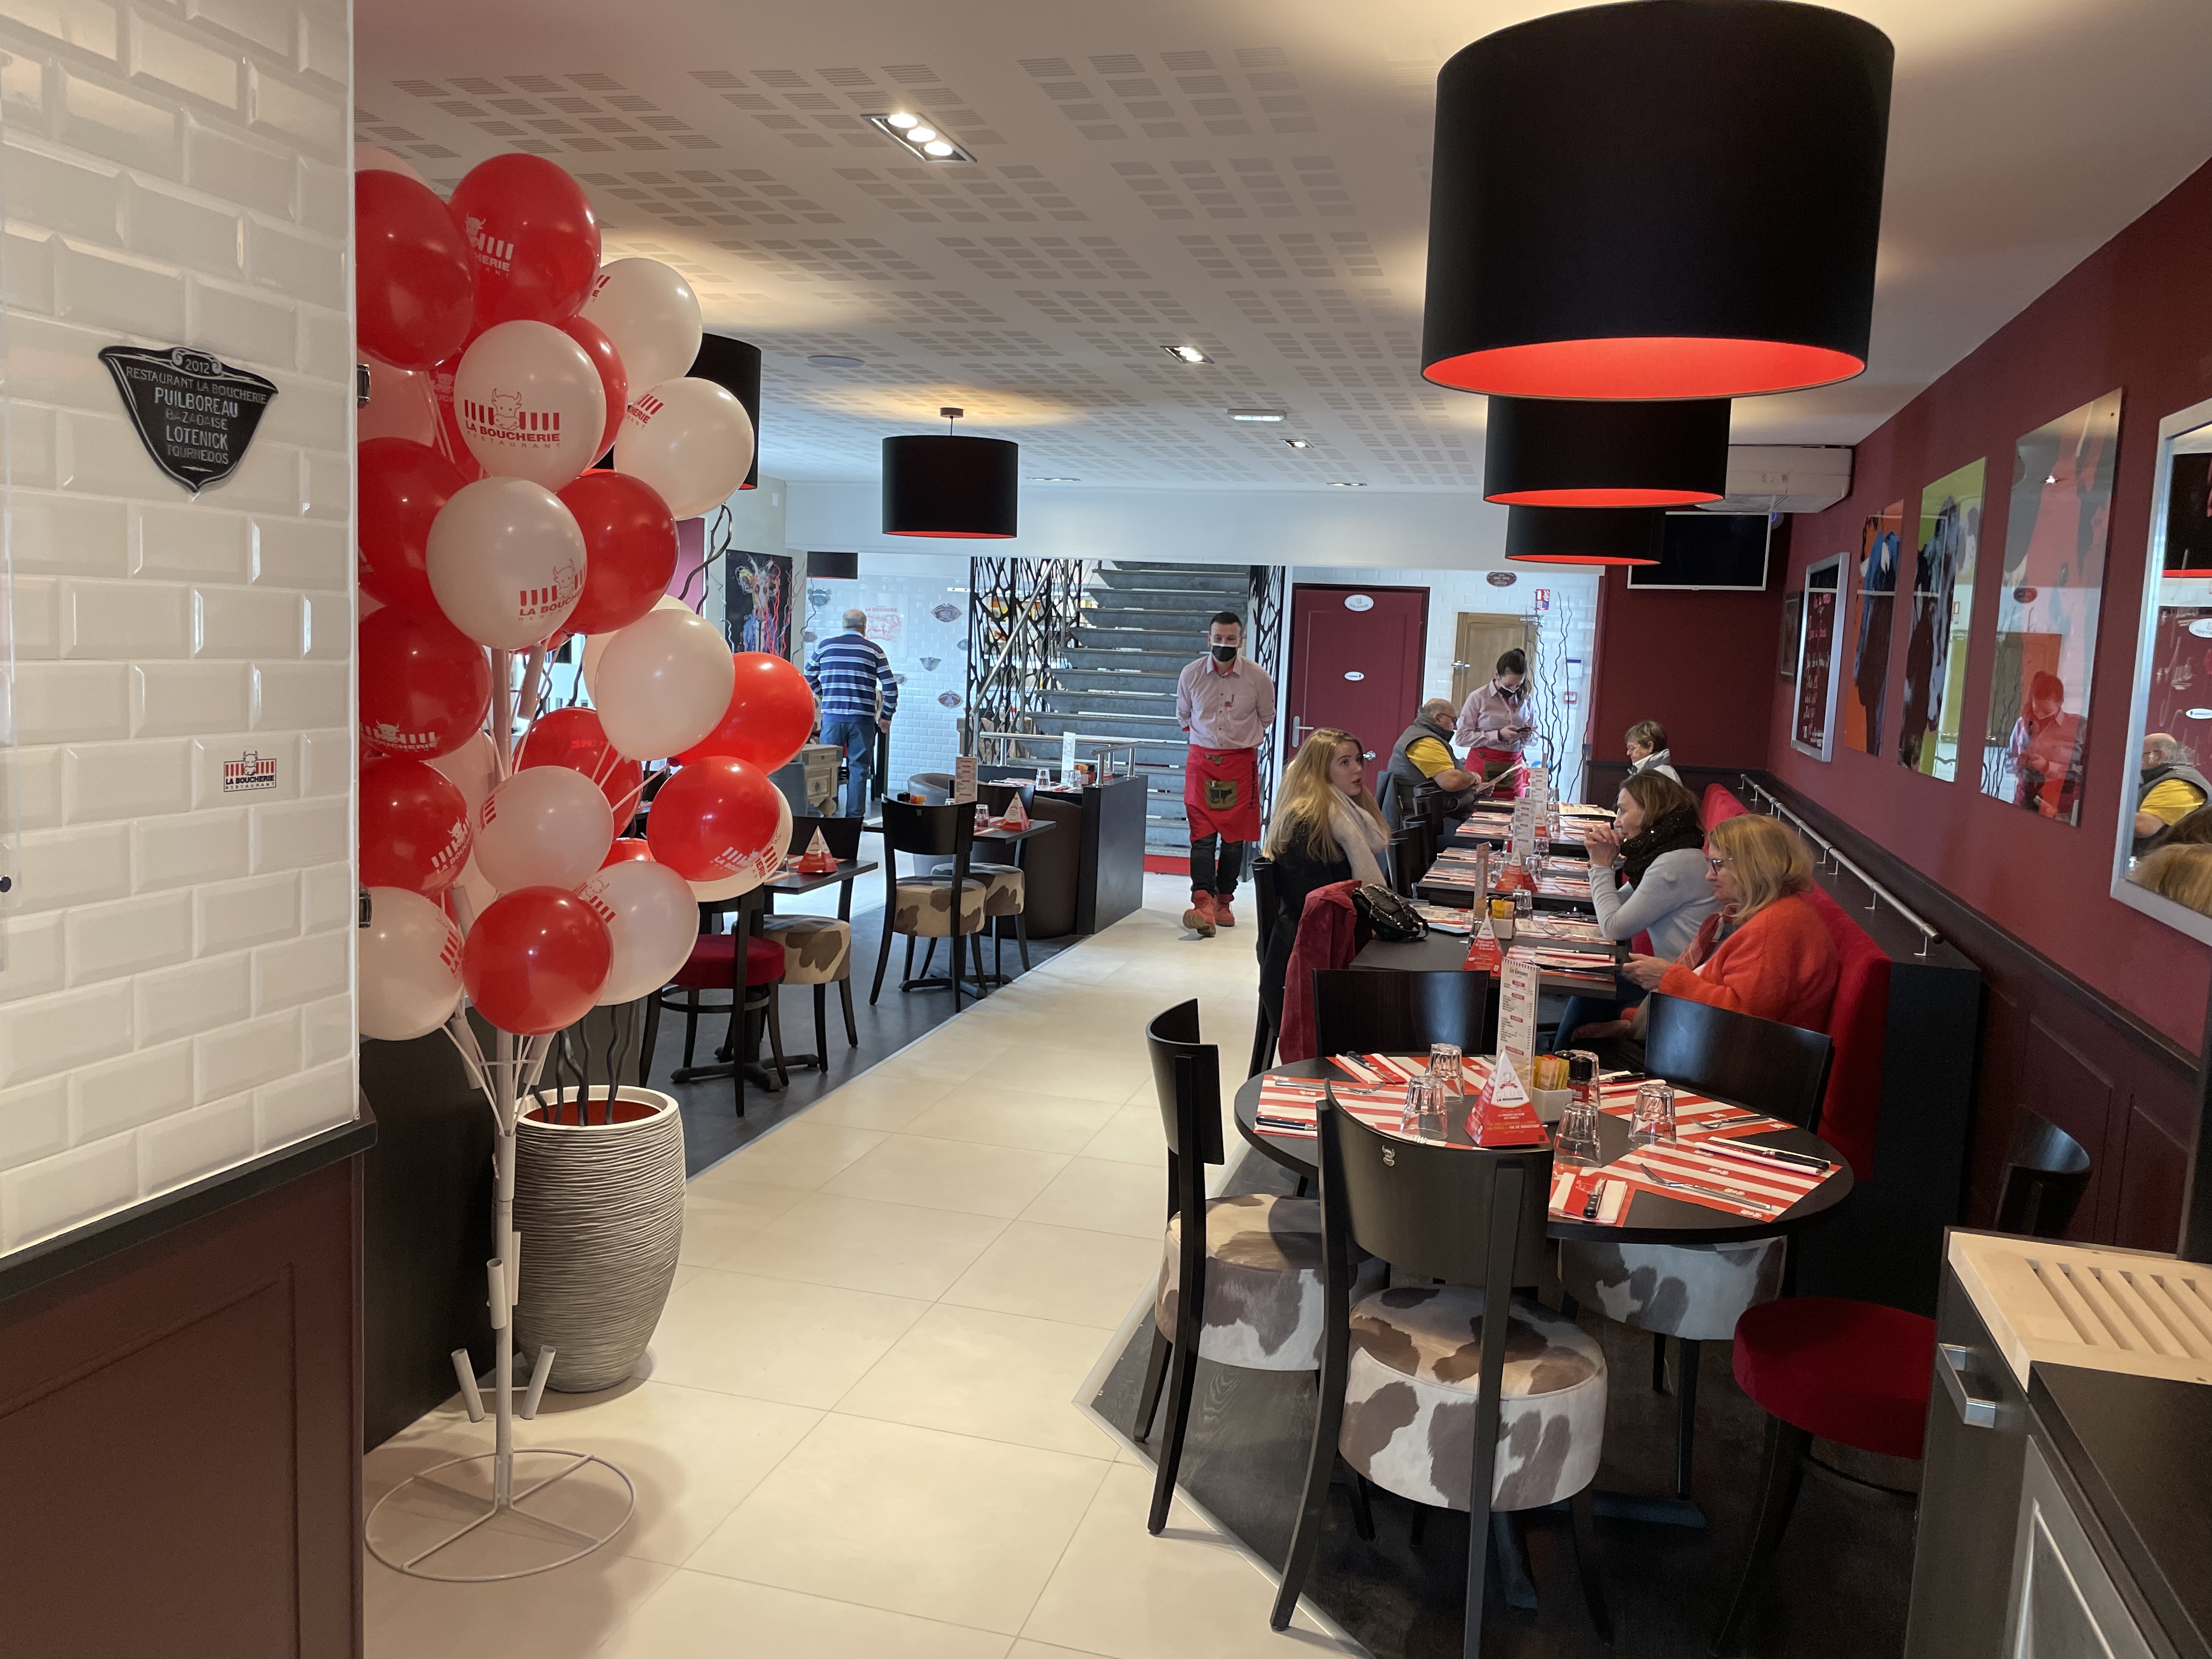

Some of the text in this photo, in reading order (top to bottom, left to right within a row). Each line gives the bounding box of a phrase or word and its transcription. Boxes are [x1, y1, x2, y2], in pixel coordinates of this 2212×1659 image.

[185, 359, 210, 374] 2012
[126, 366, 267, 404] RESTAURANT LA BOUCHERIE
[154, 387, 238, 418] PUILBOREAU
[166, 425, 228, 451] LOTENICK
[466, 420, 560, 442] LA BOUCHERIE
[467, 431, 560, 448] RESTAURANT
[166, 444, 228, 465] TOURNEDOS
[235, 775, 274, 783] BOUCHERIE
[714, 856, 725, 865] LA
[437, 865, 448, 874] LA
[1496, 1090, 1523, 1098] CLUB
